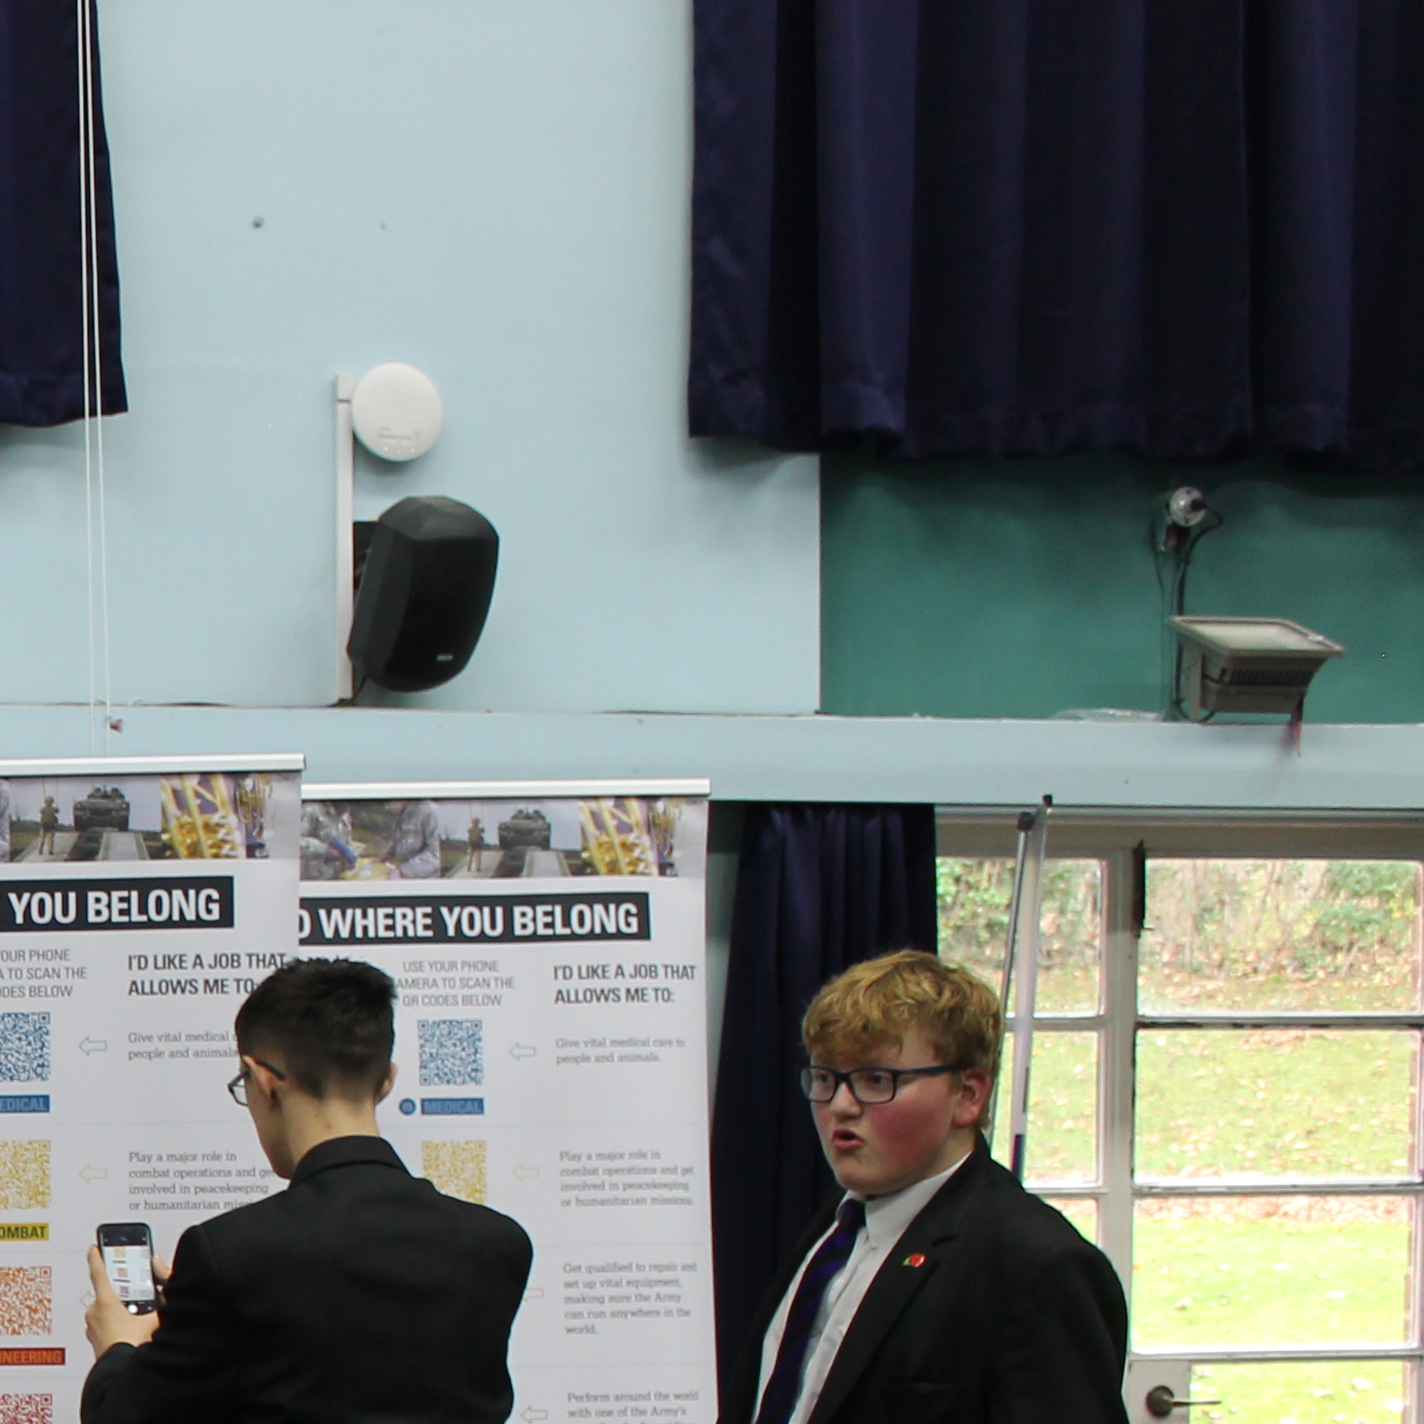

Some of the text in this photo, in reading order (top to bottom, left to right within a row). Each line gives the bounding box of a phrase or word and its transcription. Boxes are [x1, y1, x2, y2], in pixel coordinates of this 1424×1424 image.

[8, 891, 76, 924] YOU
[87, 888, 219, 922] BELONG
[320, 906, 433, 938] WHERE
[440, 904, 503, 937] YOU
[513, 902, 638, 935] BELONG
[28, 948, 70, 962] PHONE
[153, 953, 187, 970] LIKE
[192, 953, 204, 969] A
[208, 953, 241, 969] JOB
[245, 952, 288, 970] THAT
[7, 967, 22, 980] TO
[26, 967, 60, 979] SCAN
[63, 966, 86, 979] THE
[402, 959, 498, 972] USE YOUR PHONE
[577, 965, 610, 979] LIKE
[614, 965, 625, 978] A
[628, 964, 658, 979] JOB
[661, 963, 696, 980] THAT
[128, 978, 198, 996] ALLOWS
[203, 978, 228, 994] ME
[444, 976, 514, 989] TO SCAN THE
[28, 985, 73, 997] BELOW
[554, 987, 673, 1003] ALLOWS ME TO:
[402, 993, 502, 1007] QR CODES BELOW
[128, 1029, 228, 1043] Give vital medical
[128, 1046, 189, 1062] people and
[128, 1149, 236, 1166] Play a major role in
[128, 1165, 256, 1181] combat operations and
[129, 1181, 269, 1196] involved in peacekeeping
[128, 1198, 222, 1211] or humanitarian
